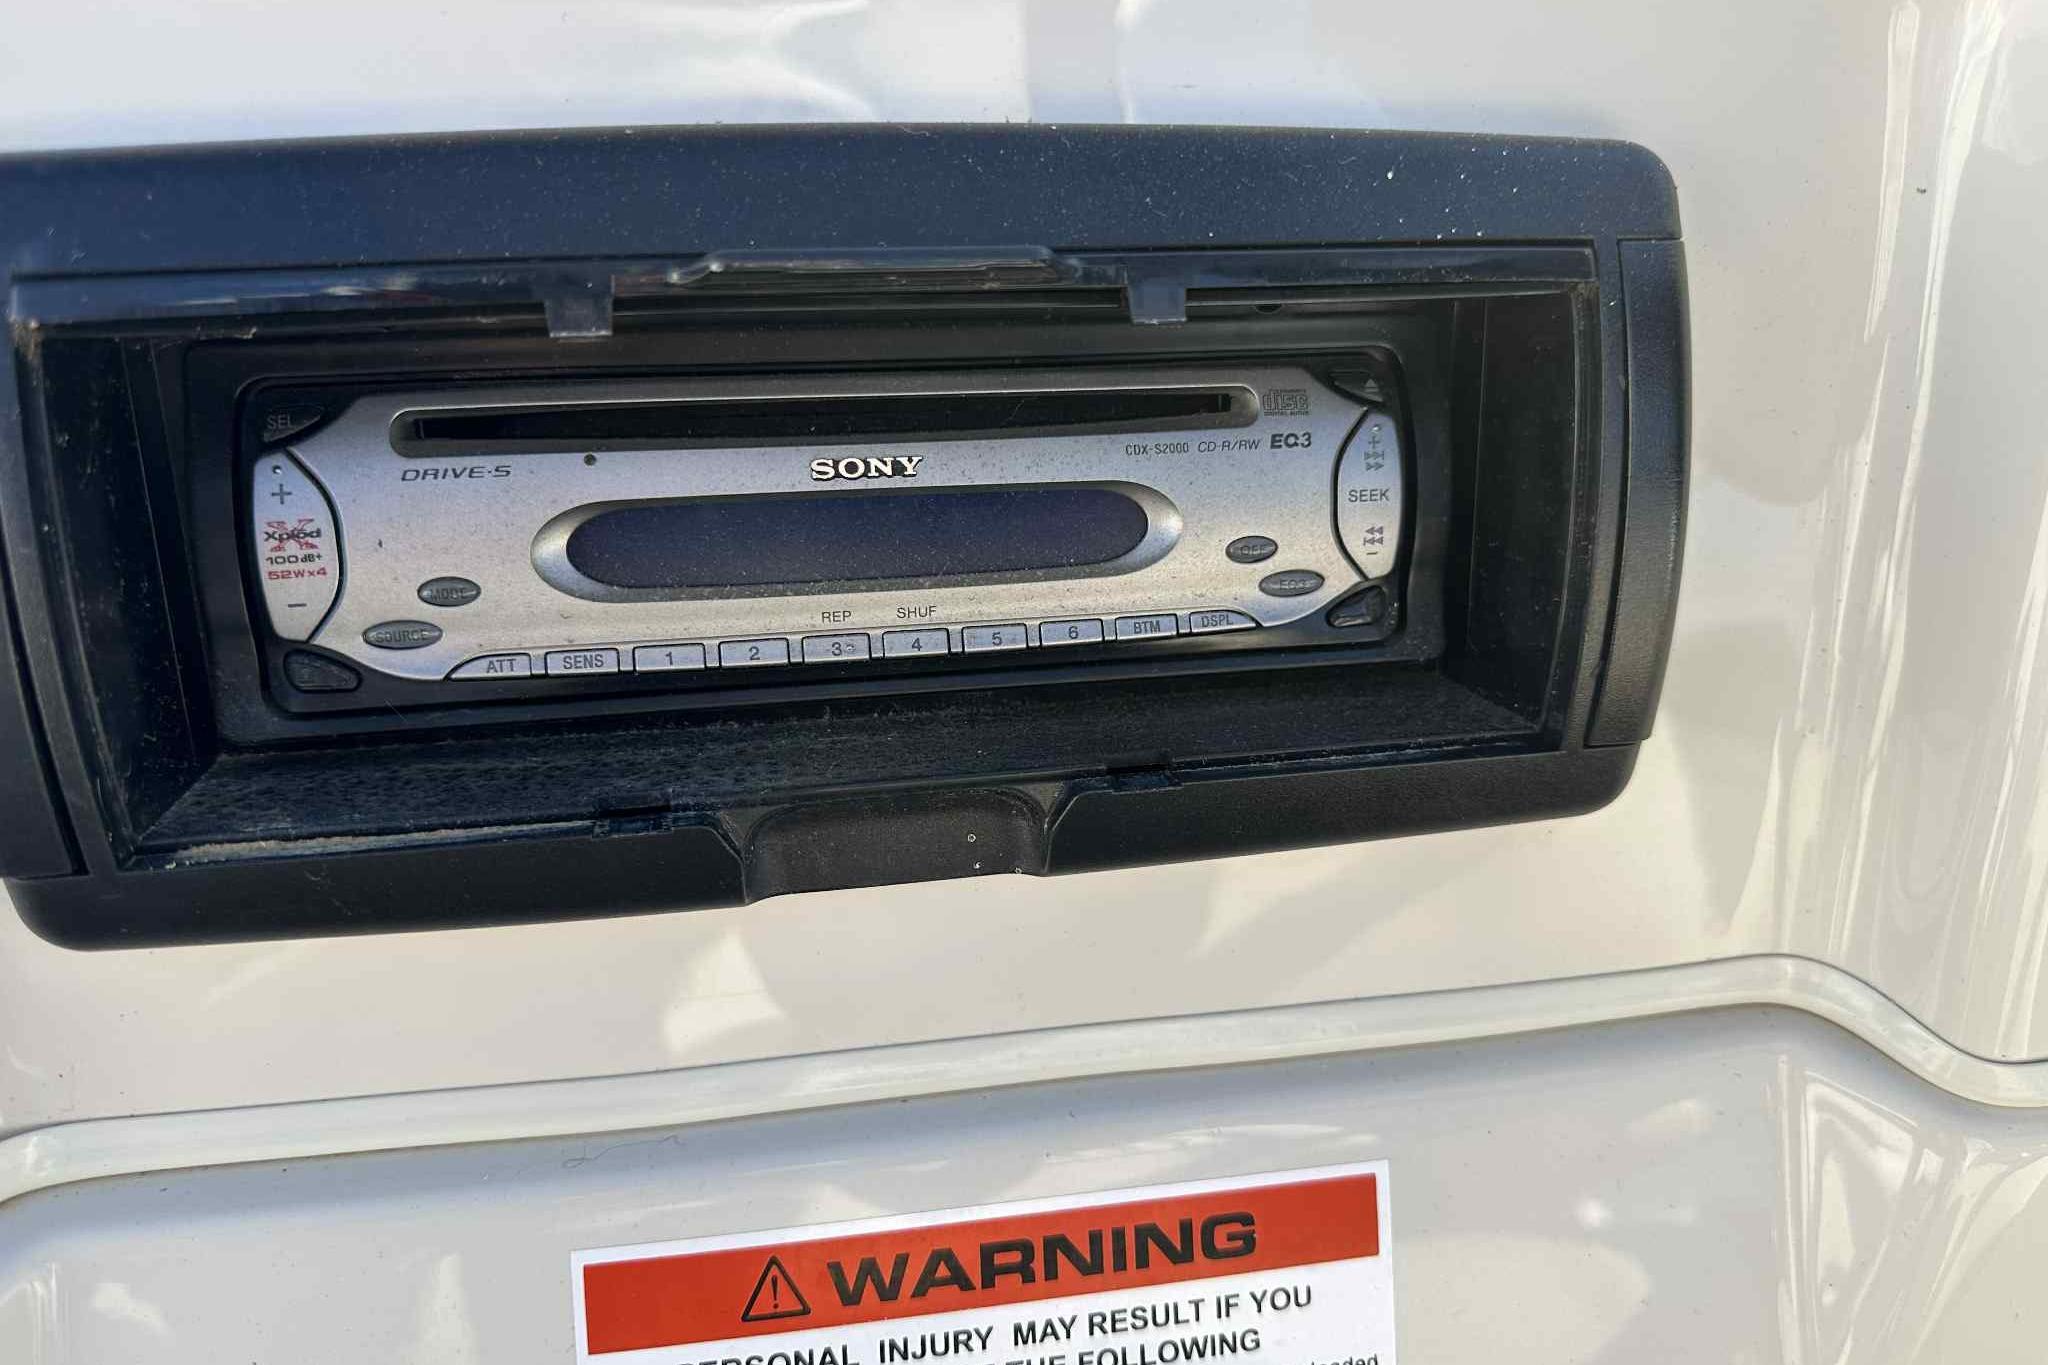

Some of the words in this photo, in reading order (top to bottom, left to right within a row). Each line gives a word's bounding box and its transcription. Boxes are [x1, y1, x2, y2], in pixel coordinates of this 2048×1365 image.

[267, 414, 292, 429] SEL
[1270, 431, 1312, 450] EQ3
[1125, 442, 1190, 456] CDX-S2000
[810, 456, 923, 481] SONY
[1348, 488, 1390, 503] SEEK
[431, 585, 469, 601] MODE
[821, 609, 852, 624] REP
[896, 605, 937, 619] SHUF
[1132, 620, 1161, 635] BTM
[1201, 614, 1234, 628] DSPL
[375, 629, 429, 643] SOURCE
[991, 632, 1003, 646] 5
[1067, 625, 1079, 640] 6
[910, 637, 922, 652] 4
[665, 651, 674, 667] 1
[748, 646, 761, 661] 2
[486, 658, 517, 674] ATT
[562, 654, 604, 670] SENS
[827, 1211, 1257, 1307] WARNING
[878, 1325, 994, 1364] INJURY
[1012, 1314, 1078, 1346] MAY
[1087, 1297, 1206, 1336] RESULT
[1215, 1293, 1241, 1320] IF
[1249, 1284, 1313, 1314] YOU
[1078, 1328, 1261, 1365] FOLLOWING
